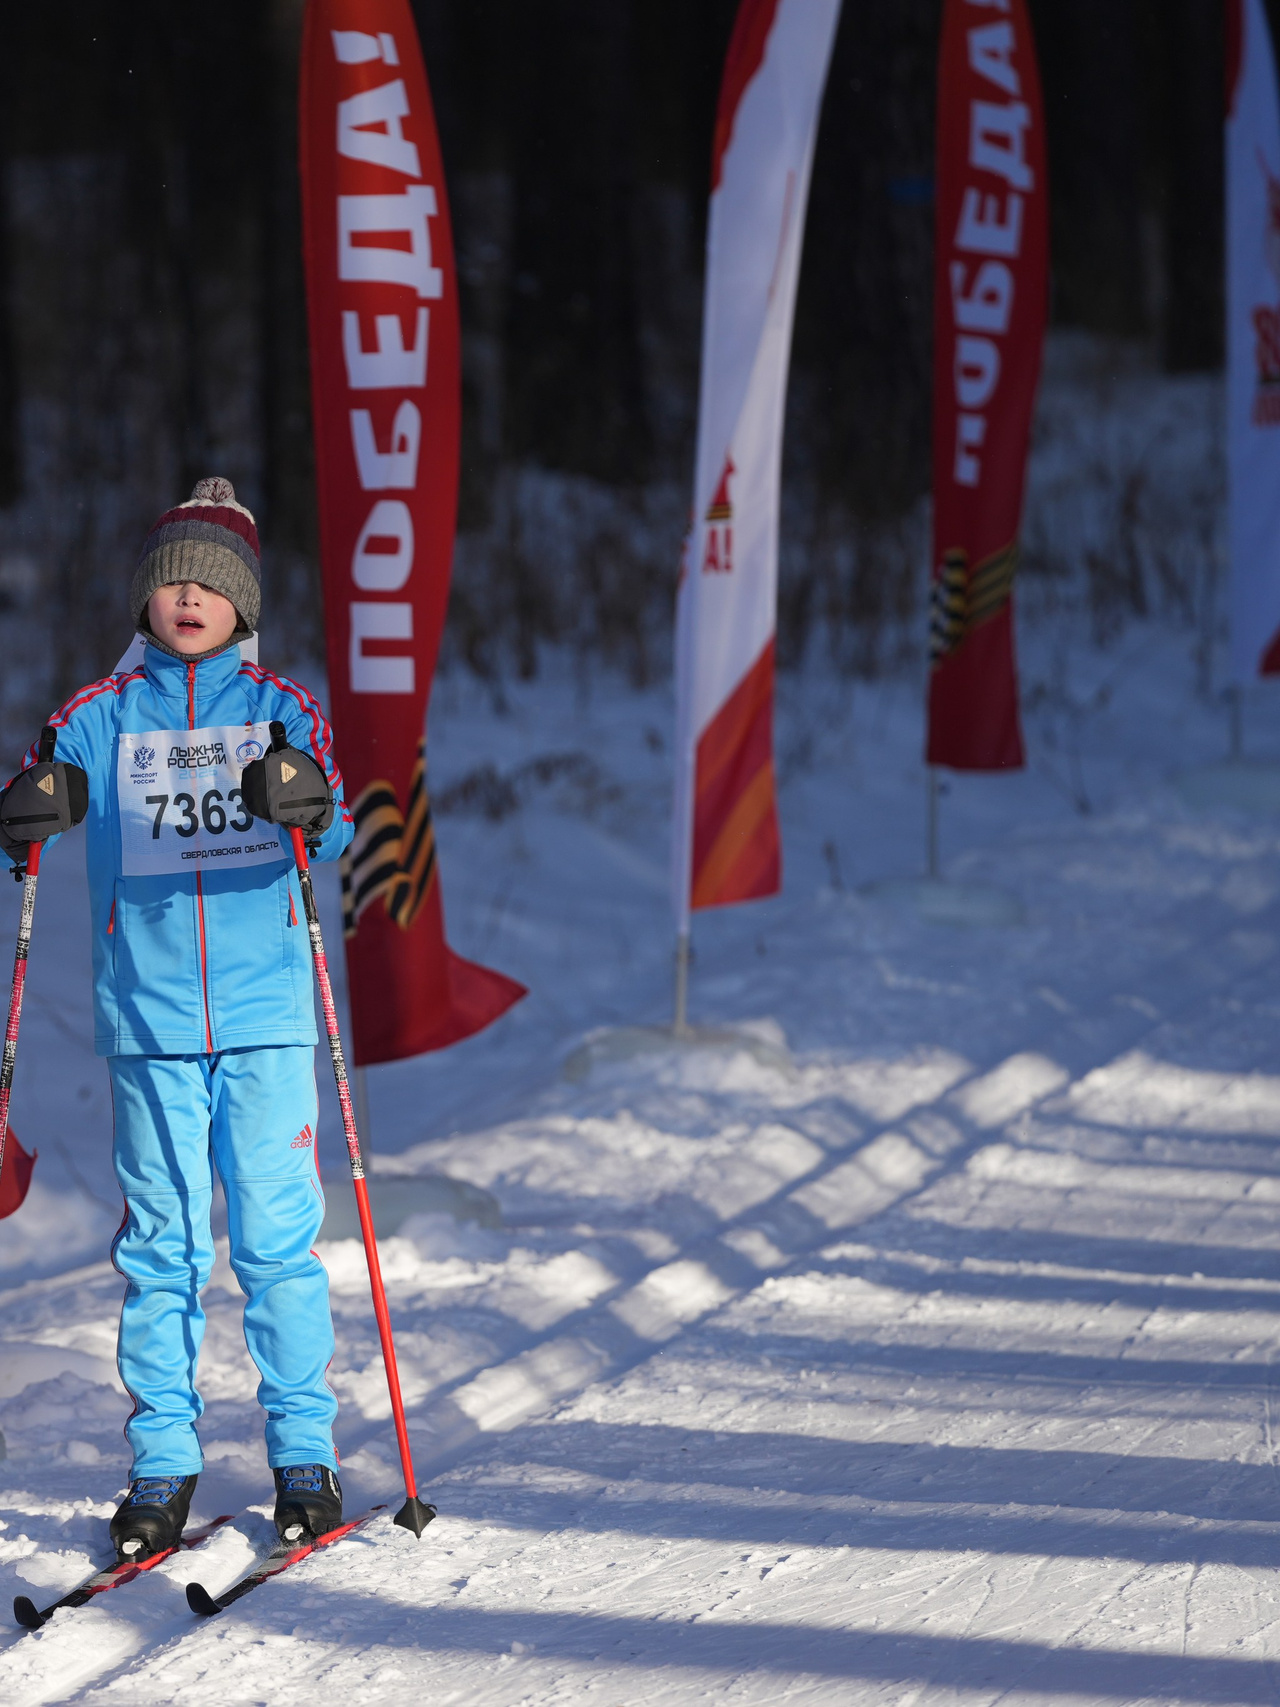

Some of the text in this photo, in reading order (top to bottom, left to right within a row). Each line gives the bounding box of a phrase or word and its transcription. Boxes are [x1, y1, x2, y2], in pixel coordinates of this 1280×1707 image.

[331, 29, 443, 692] ПОБЕДА!
[170, 743, 224, 757] ЛЫЖНЯ
[167, 754, 227, 768] РОССИИ
[179, 766, 218, 779] 2025
[145, 788, 254, 840] 7363
[181, 841, 279, 859] СВЕРДЛОВСКАЯ ОБЛАСТЬ
